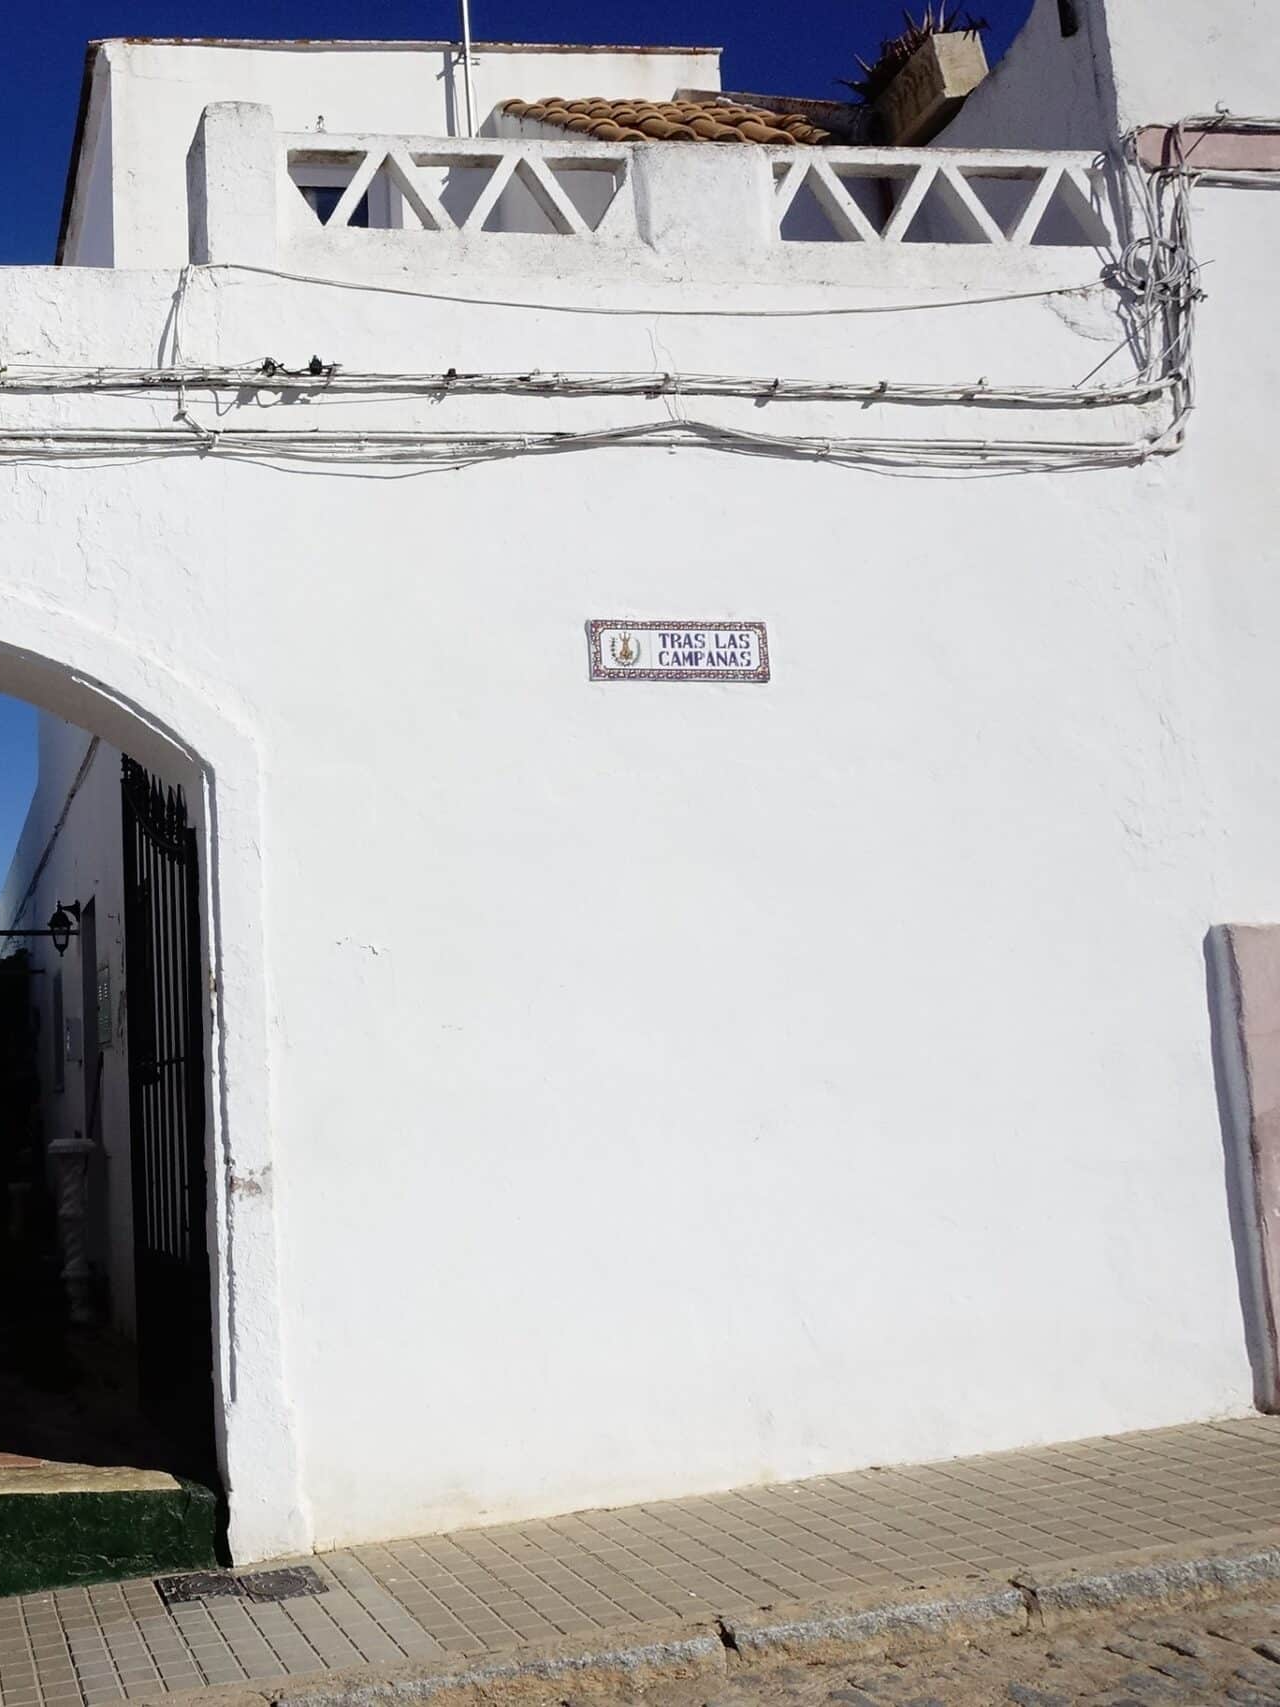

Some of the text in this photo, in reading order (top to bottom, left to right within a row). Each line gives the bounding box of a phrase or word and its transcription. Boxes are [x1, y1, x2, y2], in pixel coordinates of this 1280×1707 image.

[658, 633, 751, 649] TRAS LAS
[658, 651, 752, 667] CAMPANAS
